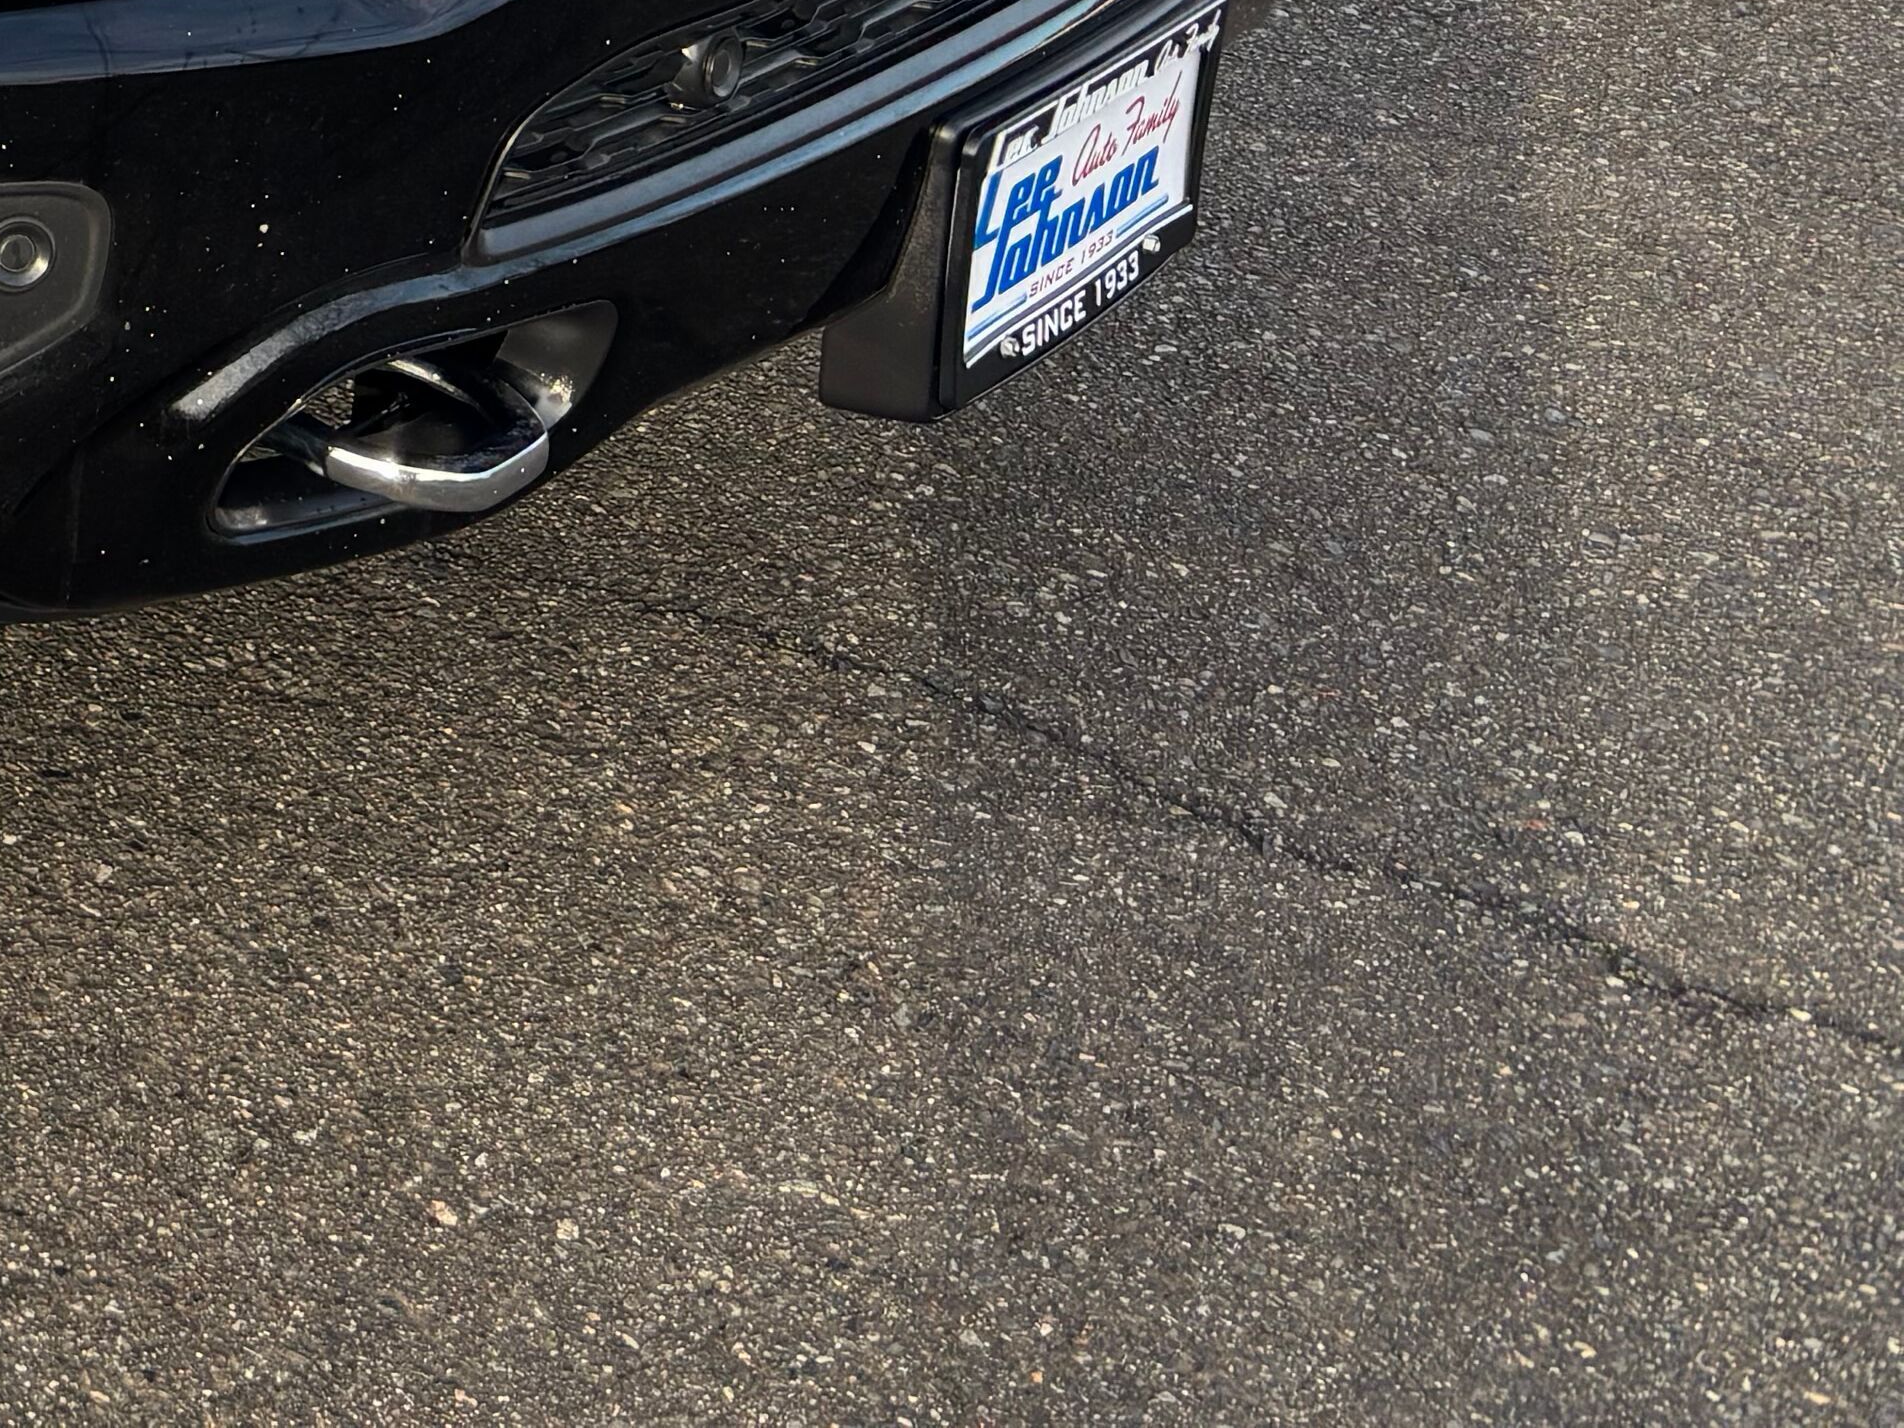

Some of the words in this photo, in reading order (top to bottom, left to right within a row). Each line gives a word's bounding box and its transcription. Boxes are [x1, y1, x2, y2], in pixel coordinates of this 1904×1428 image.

[1070, 123, 1118, 187] Auto
[1121, 70, 1184, 157] Family
[971, 145, 1160, 314] Johnson
[974, 154, 1064, 251] Lee
[1021, 289, 1087, 357] SINCE
[1095, 249, 1140, 307] 1933
[1028, 257, 1075, 298] SINCE
[1080, 229, 1115, 265] 1933
